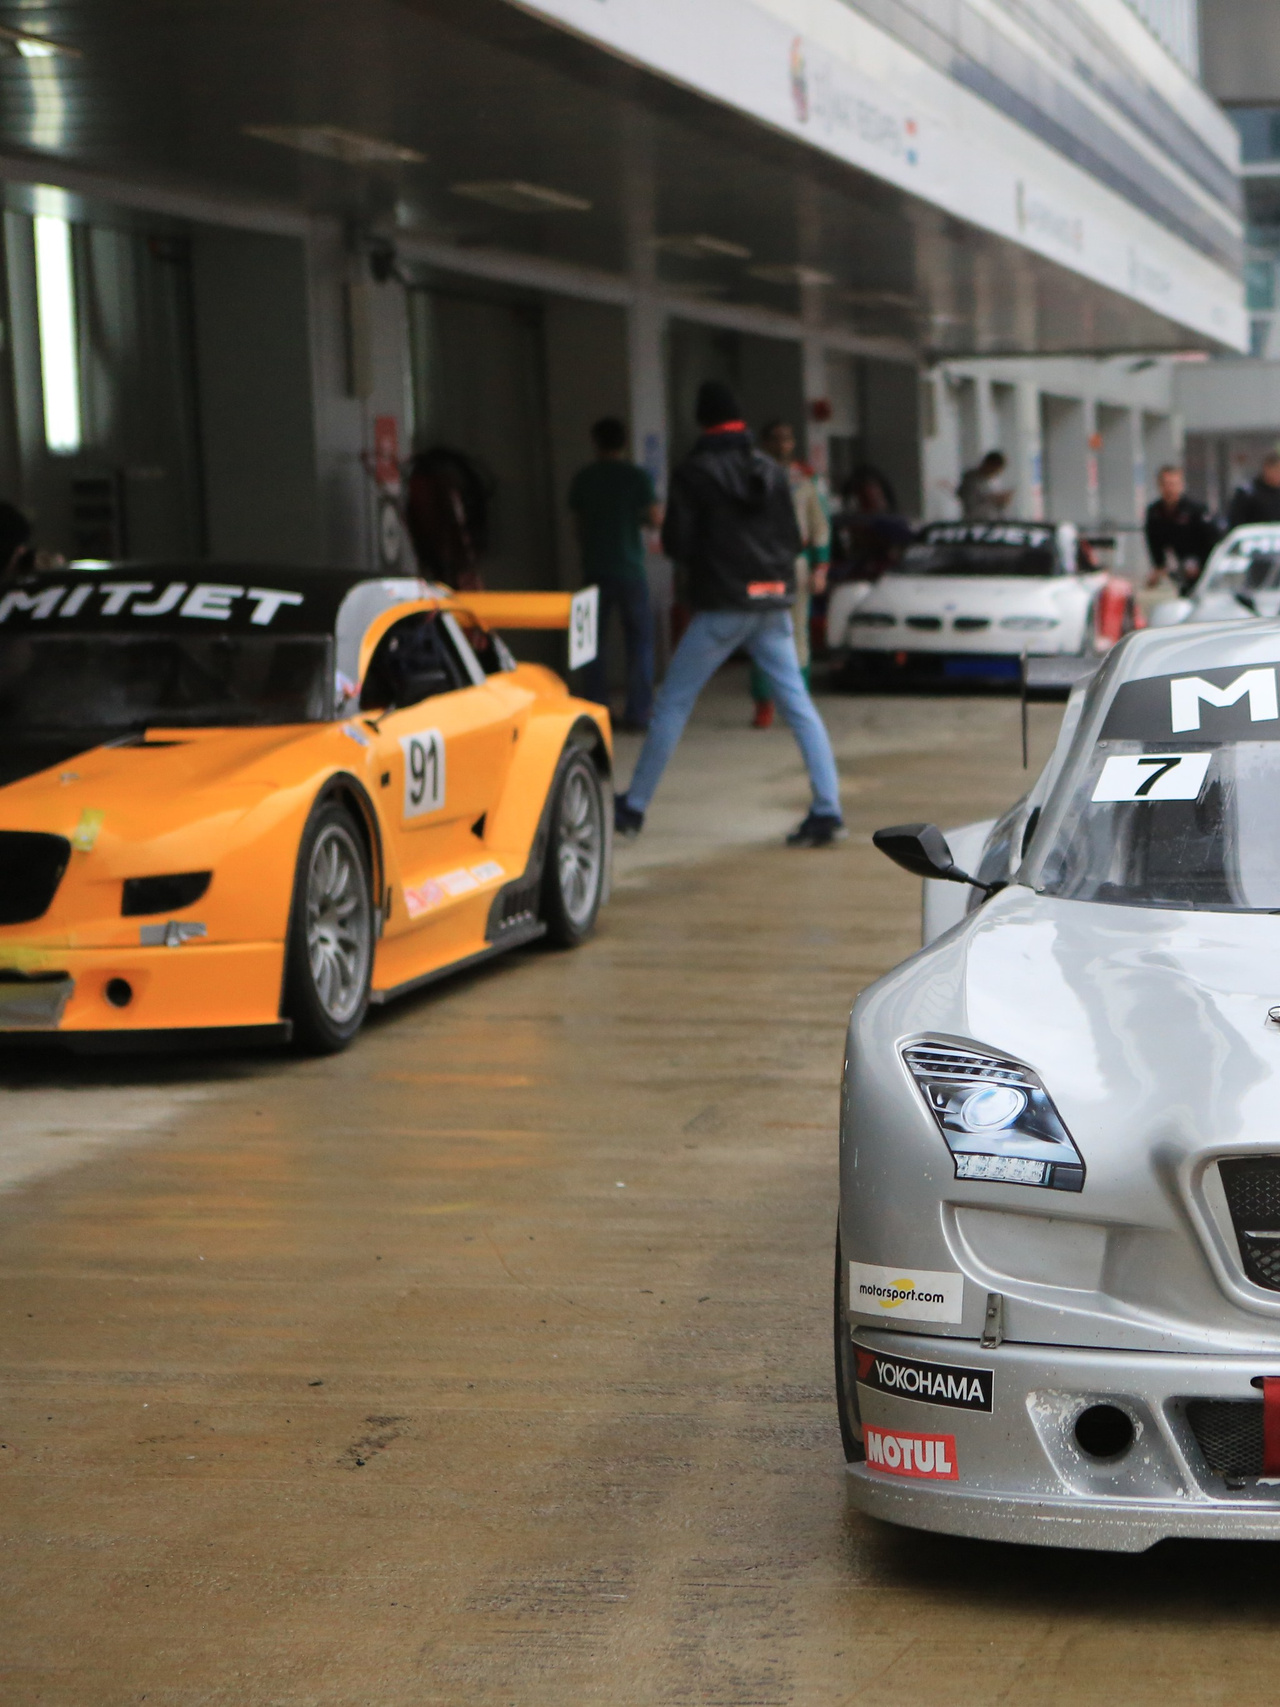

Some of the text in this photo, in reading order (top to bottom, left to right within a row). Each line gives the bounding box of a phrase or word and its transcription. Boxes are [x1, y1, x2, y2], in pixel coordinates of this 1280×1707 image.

[0, 581, 304, 625] MITJET
[575, 601, 593, 650] 91
[410, 734, 438, 806] 91
[1134, 757, 1182, 796] 7
[859, 1284, 944, 1304] motorsport.com
[875, 1360, 985, 1403] YOKOHAMA
[867, 1431, 952, 1473] MOTUL
